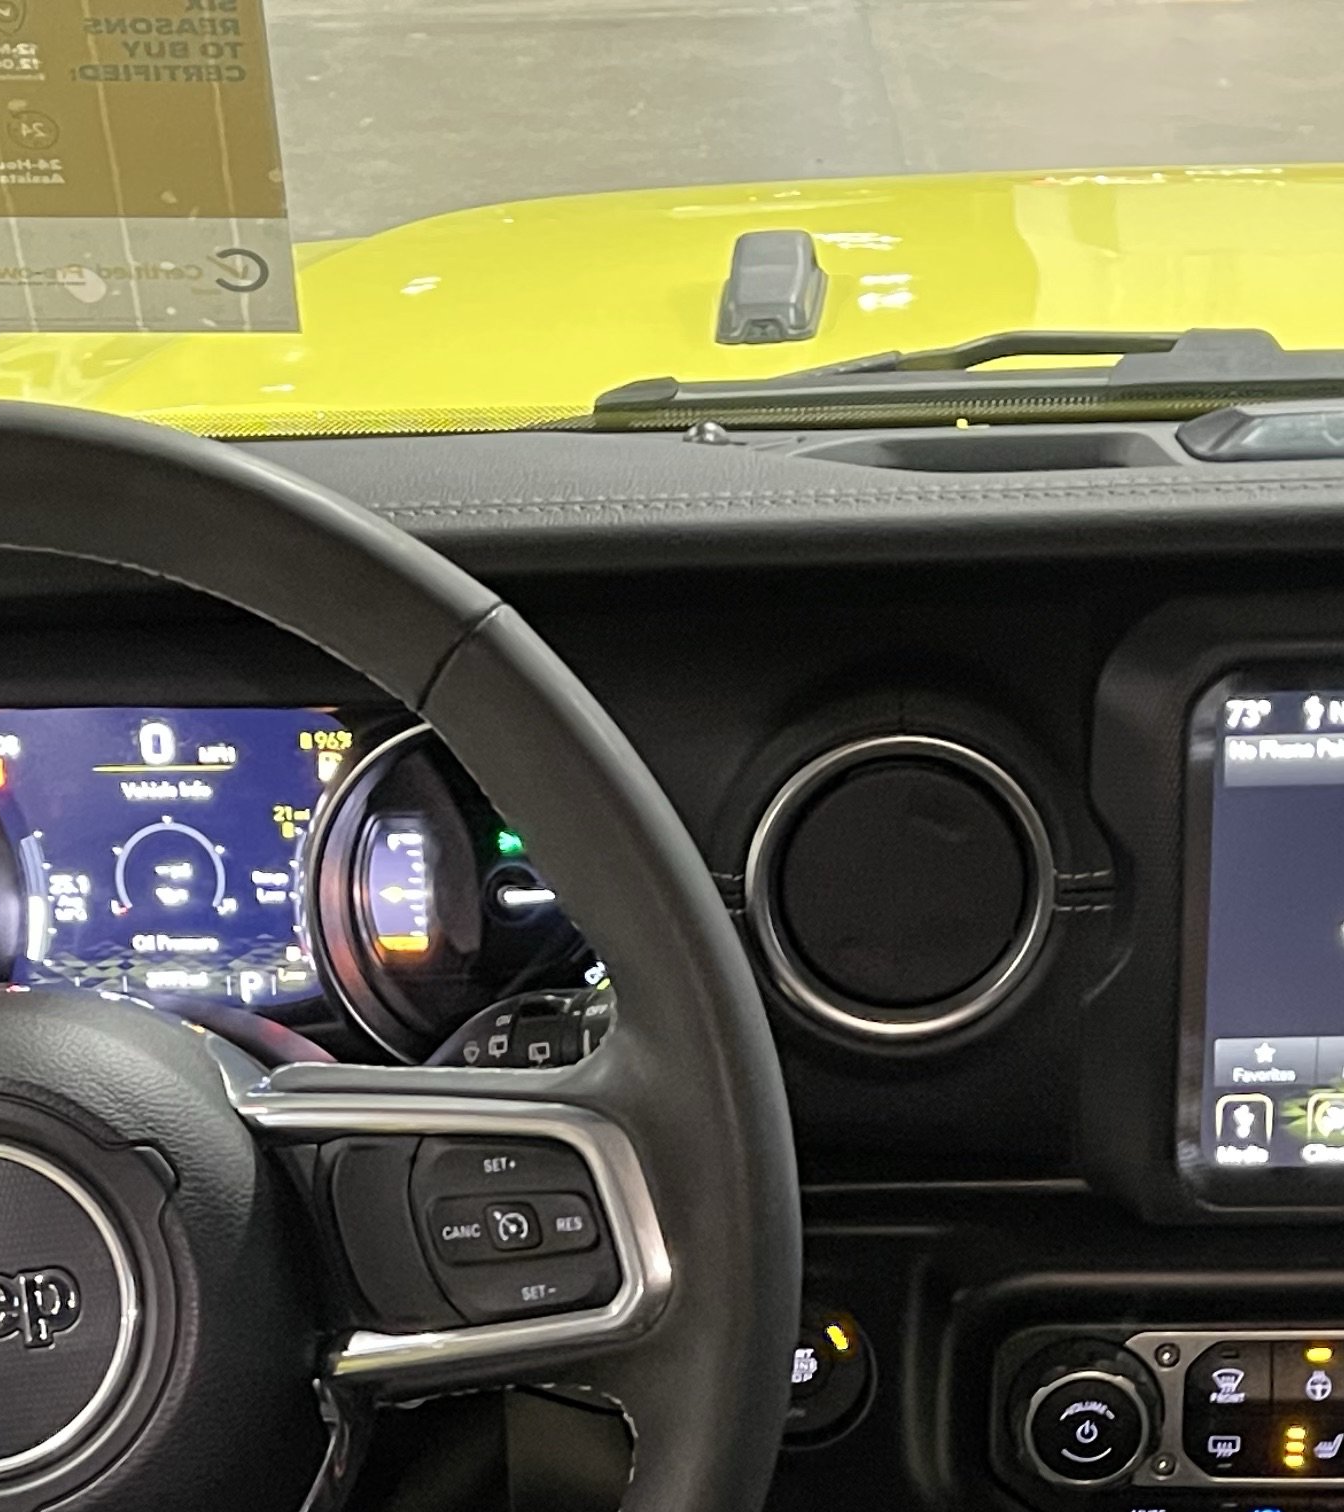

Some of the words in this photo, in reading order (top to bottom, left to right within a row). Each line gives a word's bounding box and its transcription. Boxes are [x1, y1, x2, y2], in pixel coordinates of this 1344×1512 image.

[139, 723, 176, 765] 0
[1232, 1067, 1296, 1083] Favorites
[556, 1217, 583, 1232] RES
[442, 1225, 481, 1240] CANC
